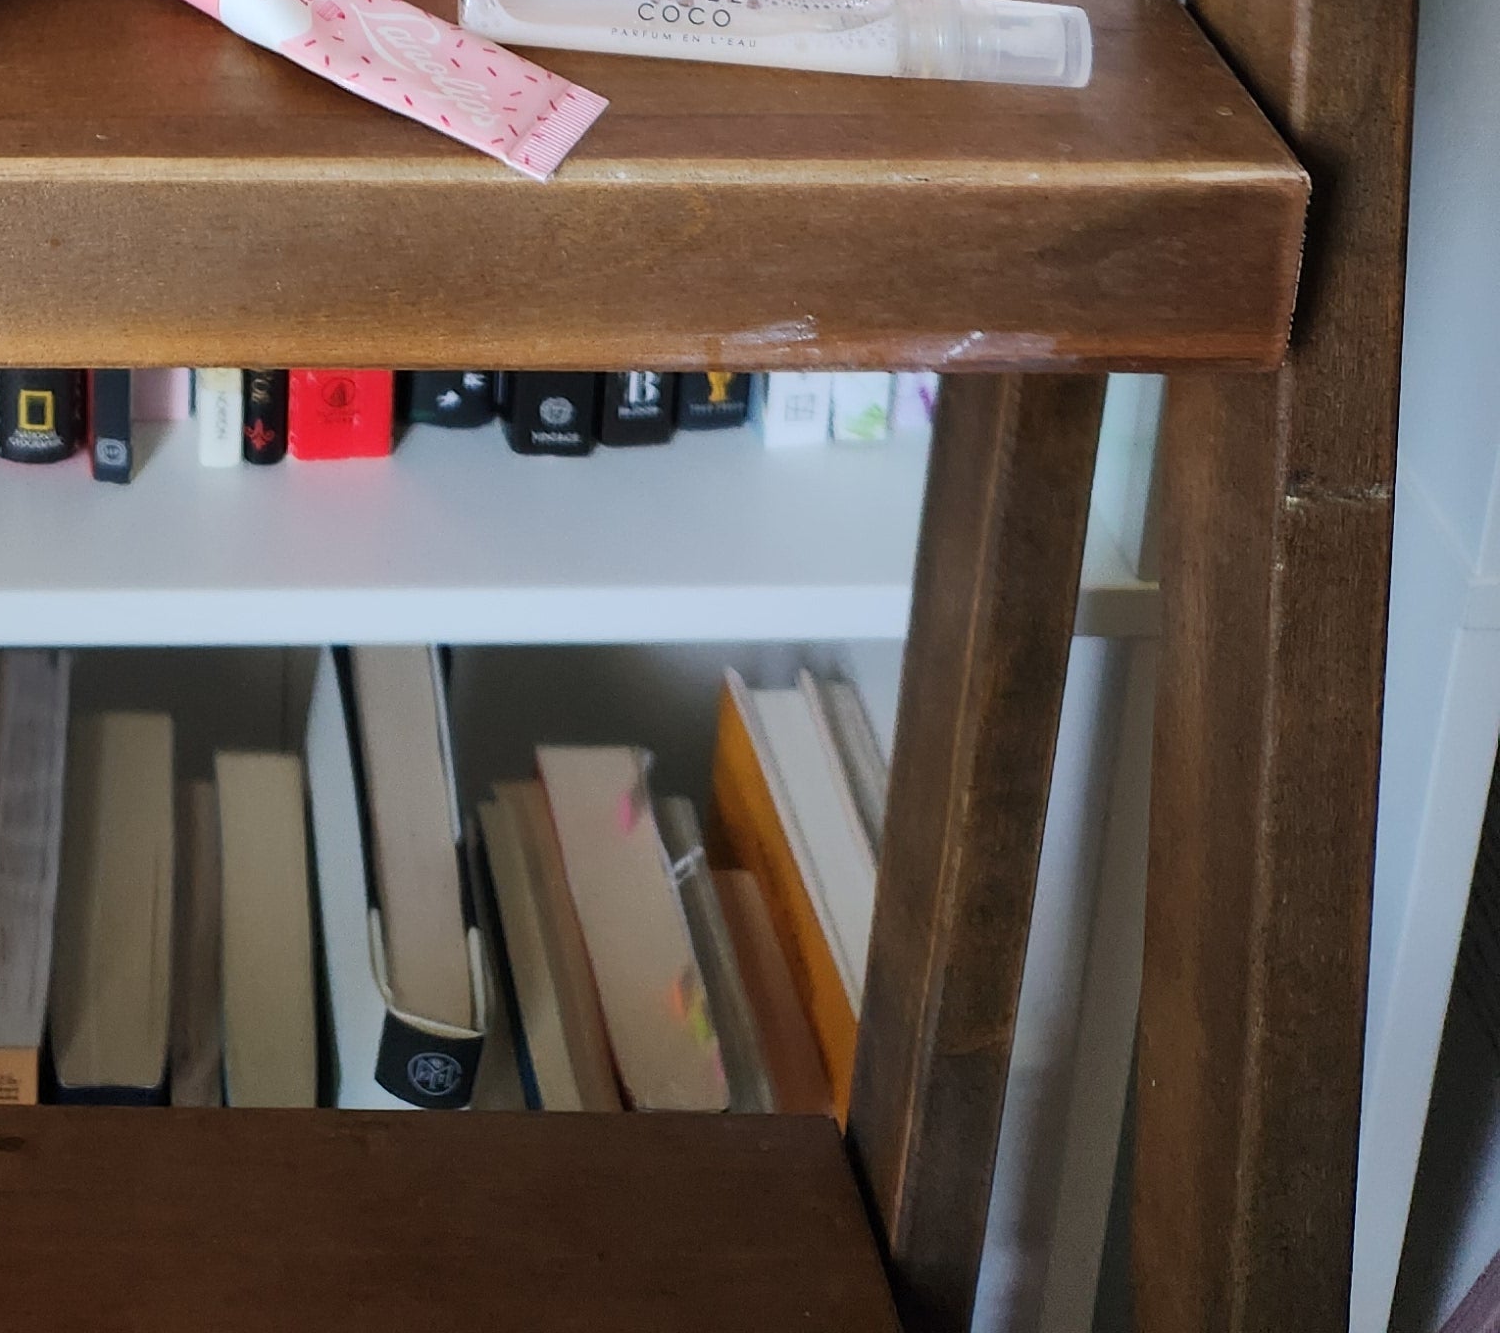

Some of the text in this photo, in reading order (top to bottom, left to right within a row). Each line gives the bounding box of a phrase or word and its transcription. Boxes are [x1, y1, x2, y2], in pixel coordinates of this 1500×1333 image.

[637, 2, 731, 28] COCO
[611, 27, 758, 49] PARFUM EN L'EAU
